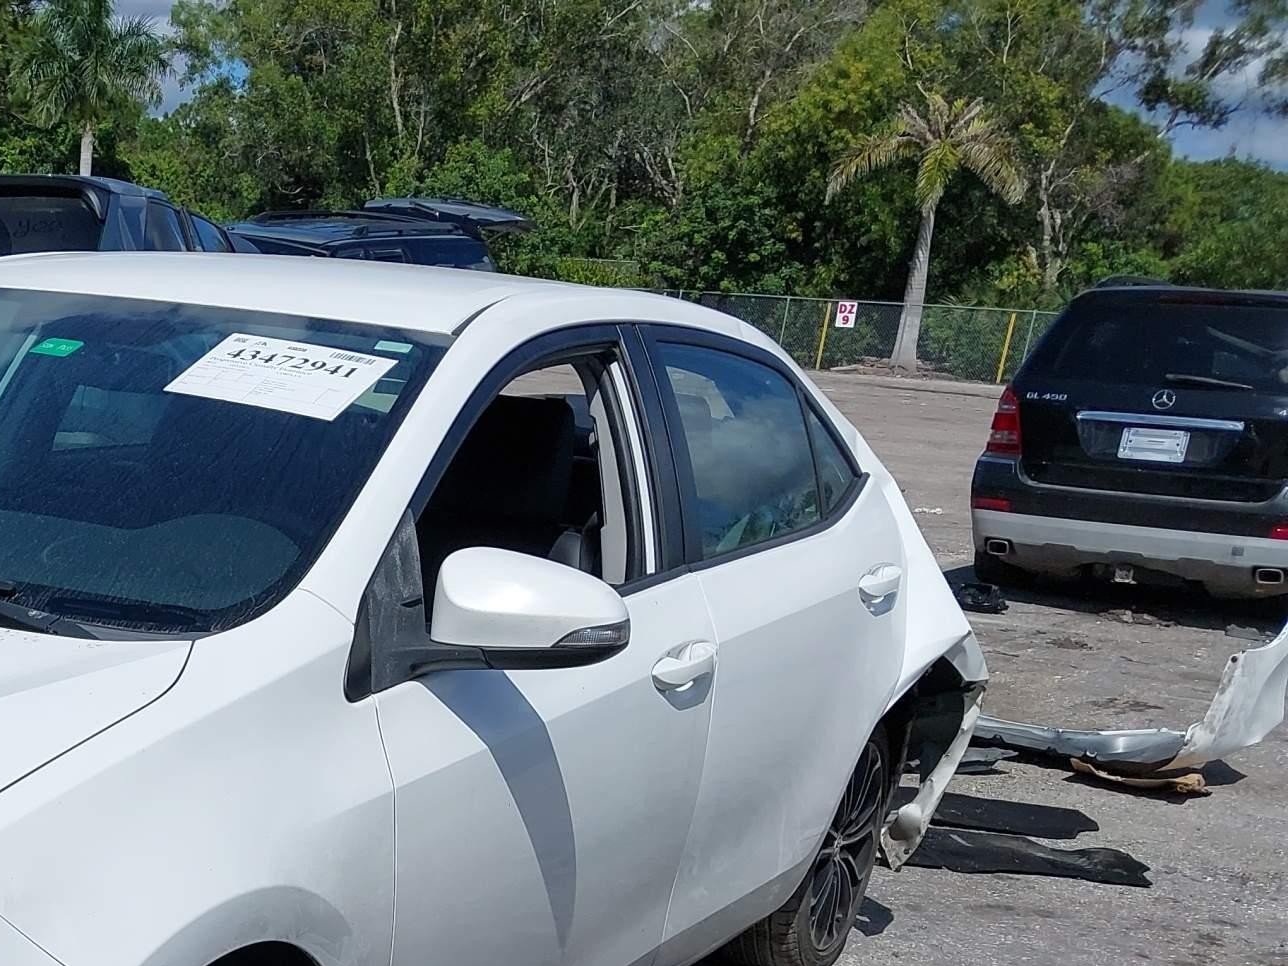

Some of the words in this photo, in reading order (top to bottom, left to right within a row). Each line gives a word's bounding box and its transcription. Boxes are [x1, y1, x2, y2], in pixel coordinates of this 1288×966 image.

[838, 303, 856, 314] DZ
[841, 315, 850, 325] 9
[226, 348, 359, 378] 43472941
